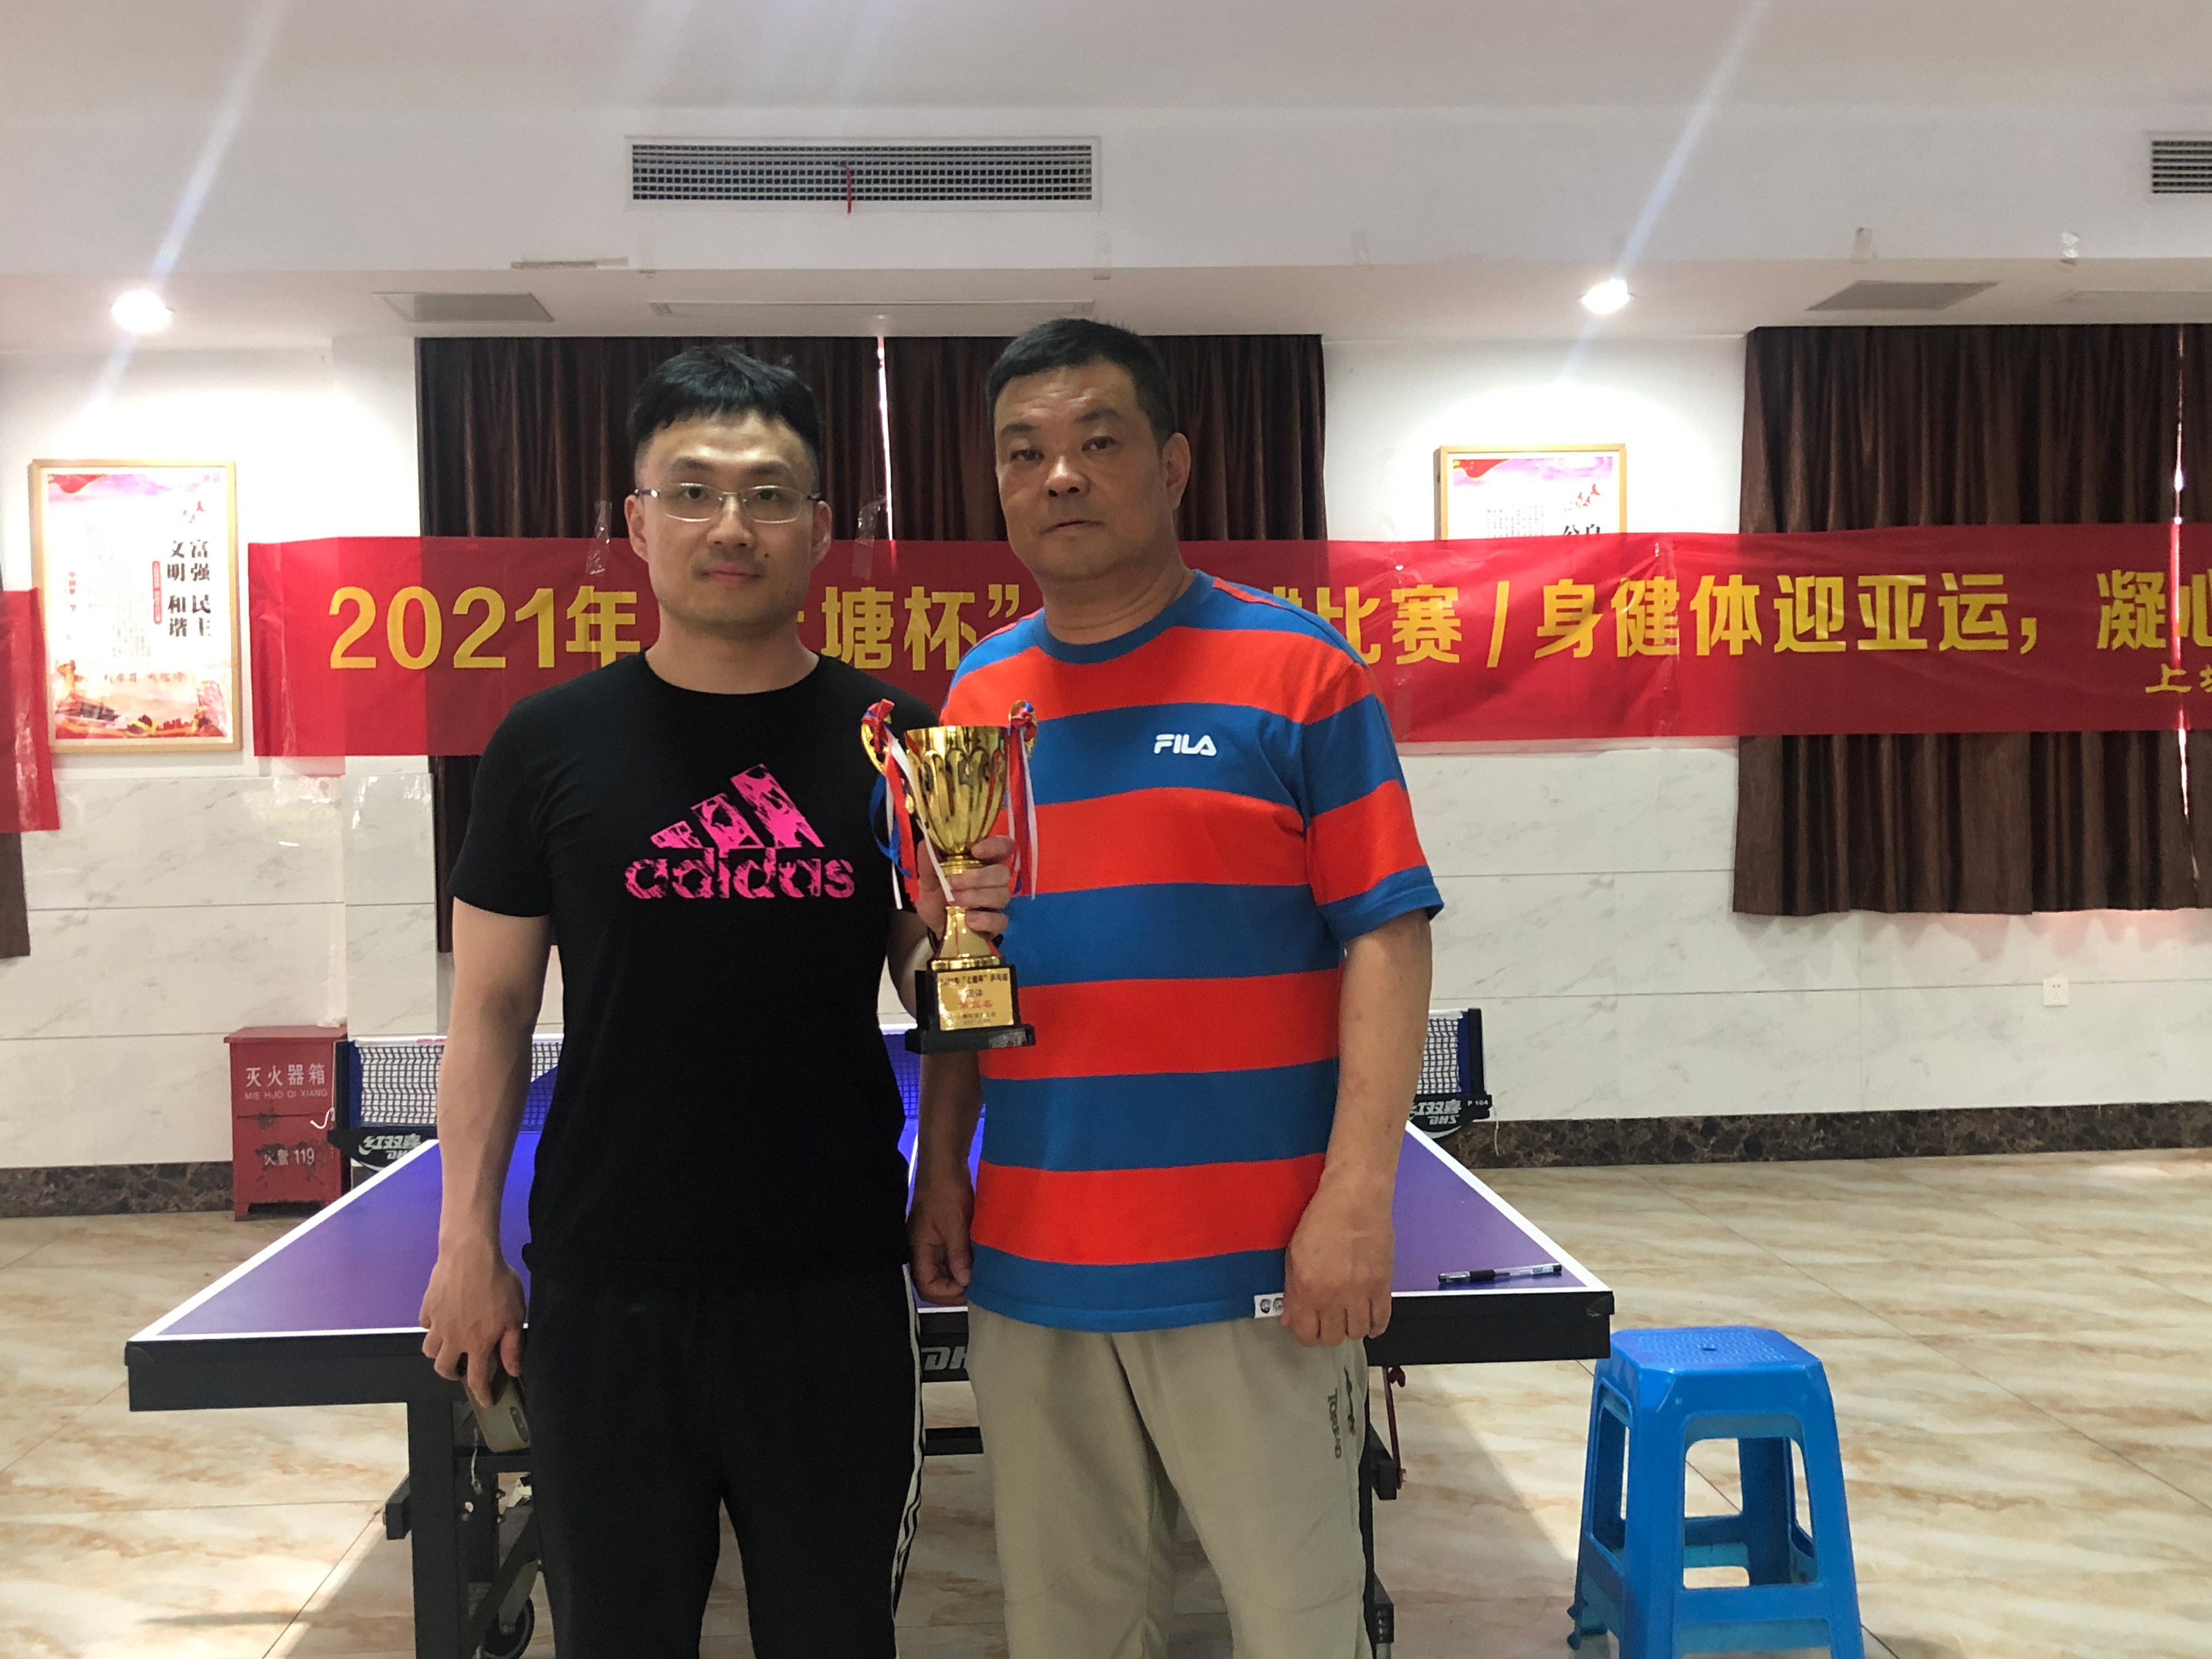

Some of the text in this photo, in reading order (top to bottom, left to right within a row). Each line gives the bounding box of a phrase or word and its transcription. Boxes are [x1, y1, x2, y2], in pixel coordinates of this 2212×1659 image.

[329, 585, 640, 670] 2021年
[797, 584, 1020, 670] 塘杯”
[1154, 733, 1217, 757] FILA
[624, 847, 855, 899] adidas
[245, 1063, 325, 1088] 灭火器箱
[287, 1090, 296, 1098] QI
[301, 1088, 328, 1097] XIANG
[1427, 1115, 1460, 1125] DHS
[294, 1147, 315, 1166] 119
[385, 1150, 413, 1160] DH
